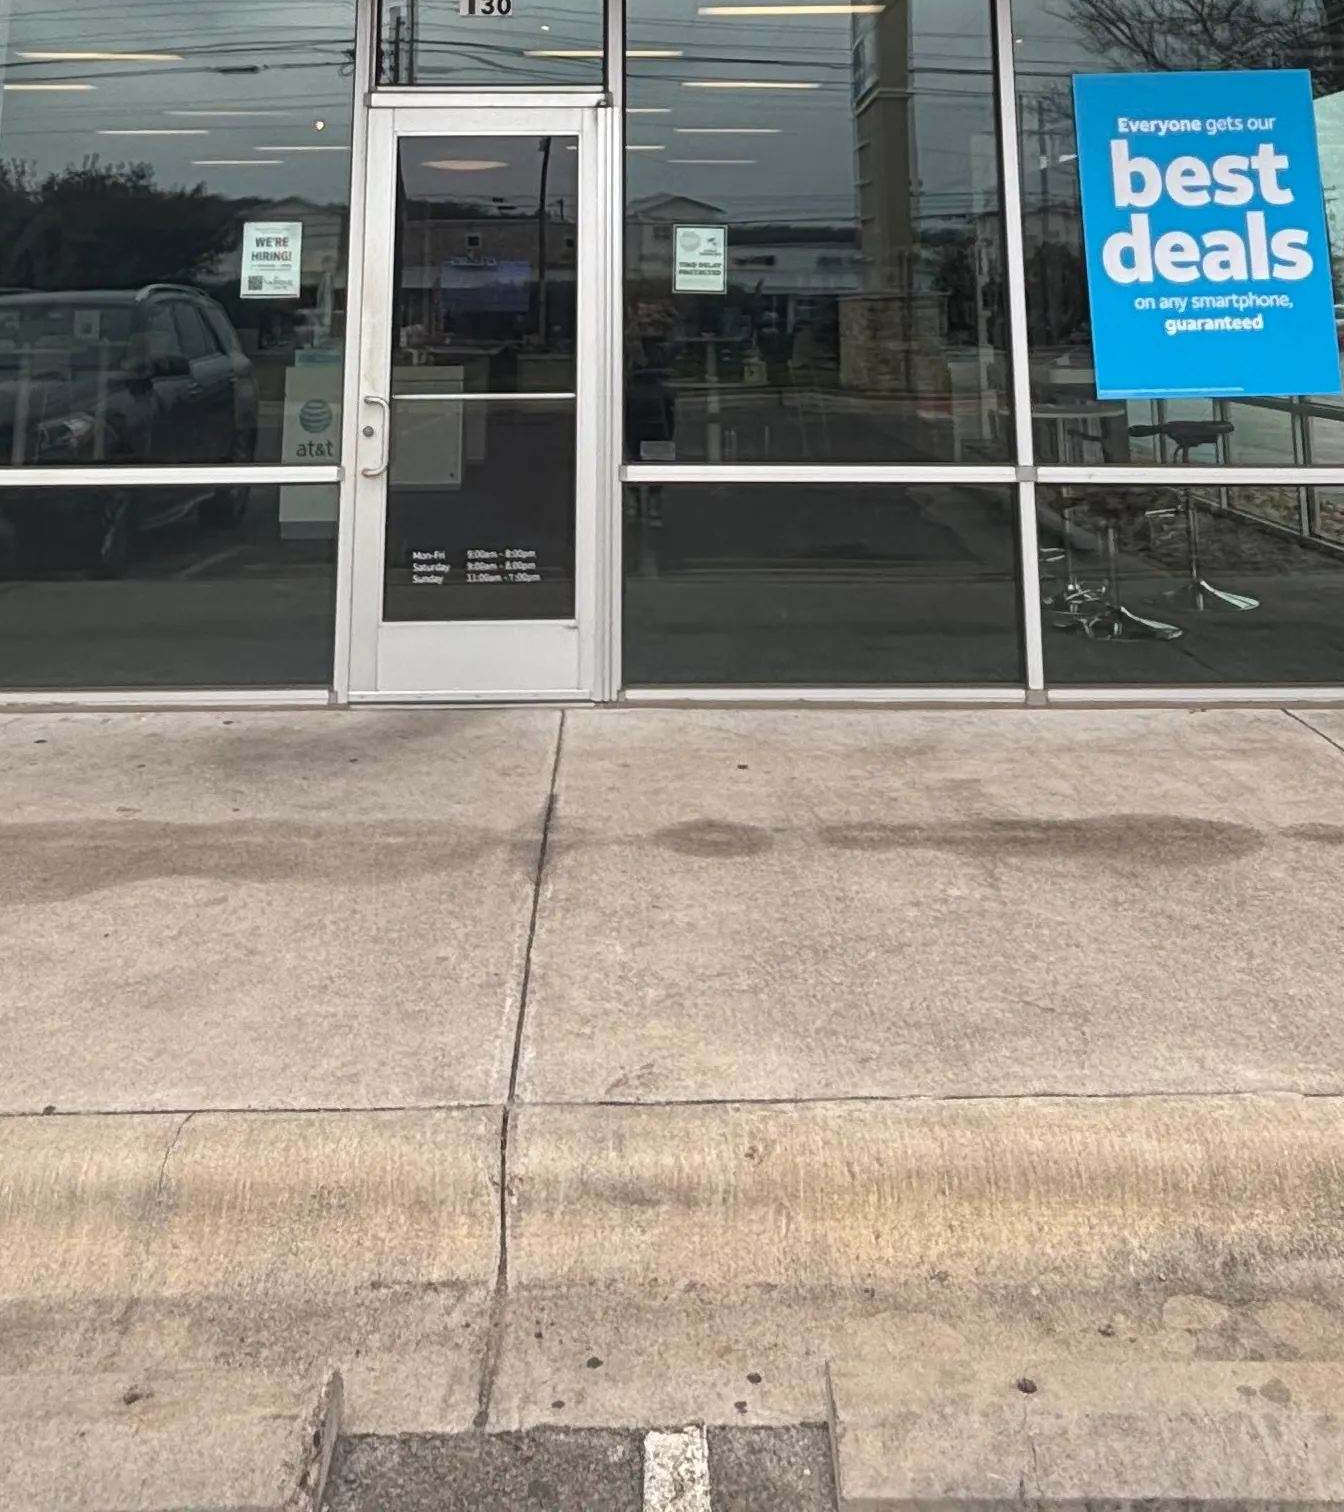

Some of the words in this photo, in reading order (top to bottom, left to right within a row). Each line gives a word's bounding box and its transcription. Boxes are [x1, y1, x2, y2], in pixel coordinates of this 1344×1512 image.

[1117, 117, 1202, 136] Everyone
[1205, 116, 1244, 135] gets
[1247, 117, 1277, 131] our
[1110, 138, 1295, 209] best
[255, 236, 290, 248] WE'RE
[1101, 210, 1315, 285] deals
[250, 251, 293, 262] HIRING!
[1134, 296, 1156, 310] on
[1159, 296, 1187, 313] any
[1191, 292, 1294, 311] smartphone,
[1164, 314, 1265, 336] guaranteed
[296, 439, 334, 457] at&t
[412, 550, 446, 560] Mon-Fri
[412, 562, 451, 573] Saturday
[412, 574, 444, 585] Sunday
